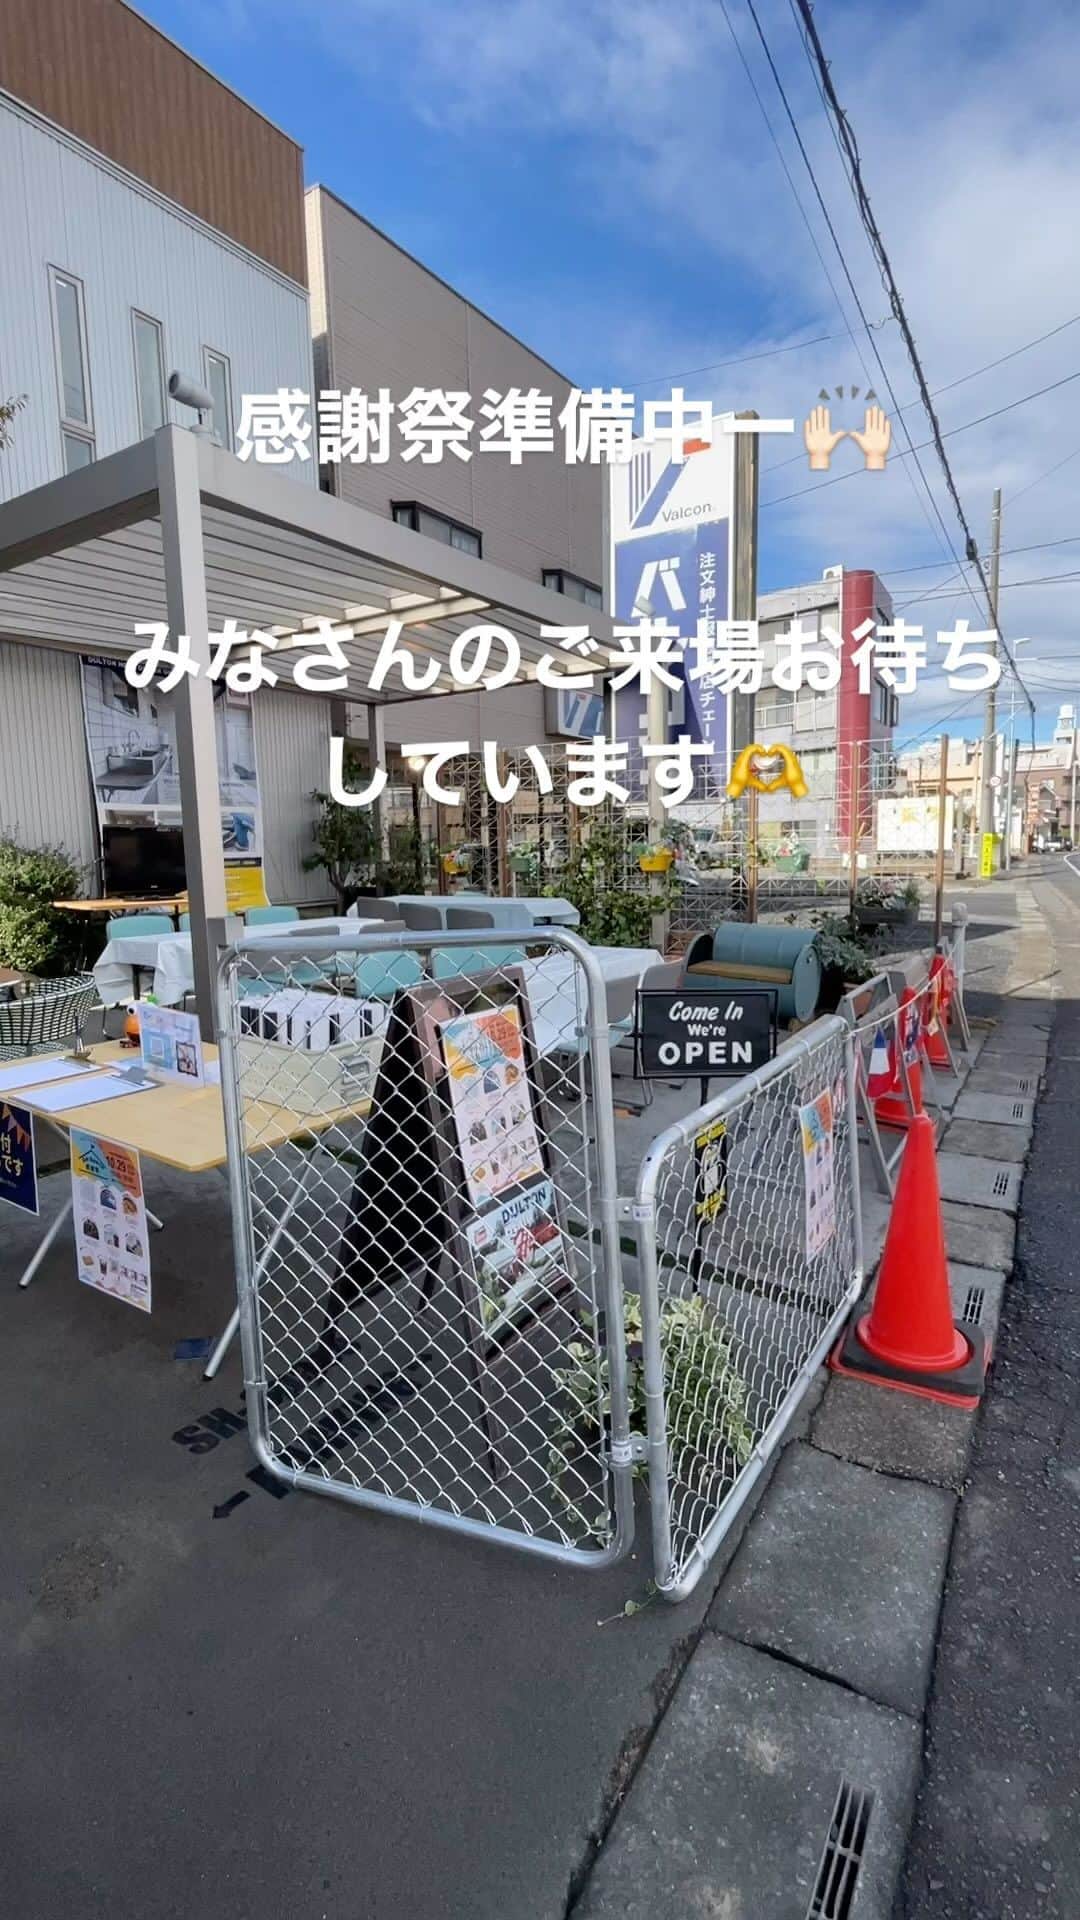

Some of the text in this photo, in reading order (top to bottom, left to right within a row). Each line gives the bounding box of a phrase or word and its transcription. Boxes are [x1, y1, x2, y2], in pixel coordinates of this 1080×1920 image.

[661, 502, 712, 523] Valcon
[669, 1001, 744, 1021] Come In
[687, 1024, 727, 1036] We're
[658, 1041, 753, 1066] OPEN
[502, 1186, 547, 1225] DULTON
